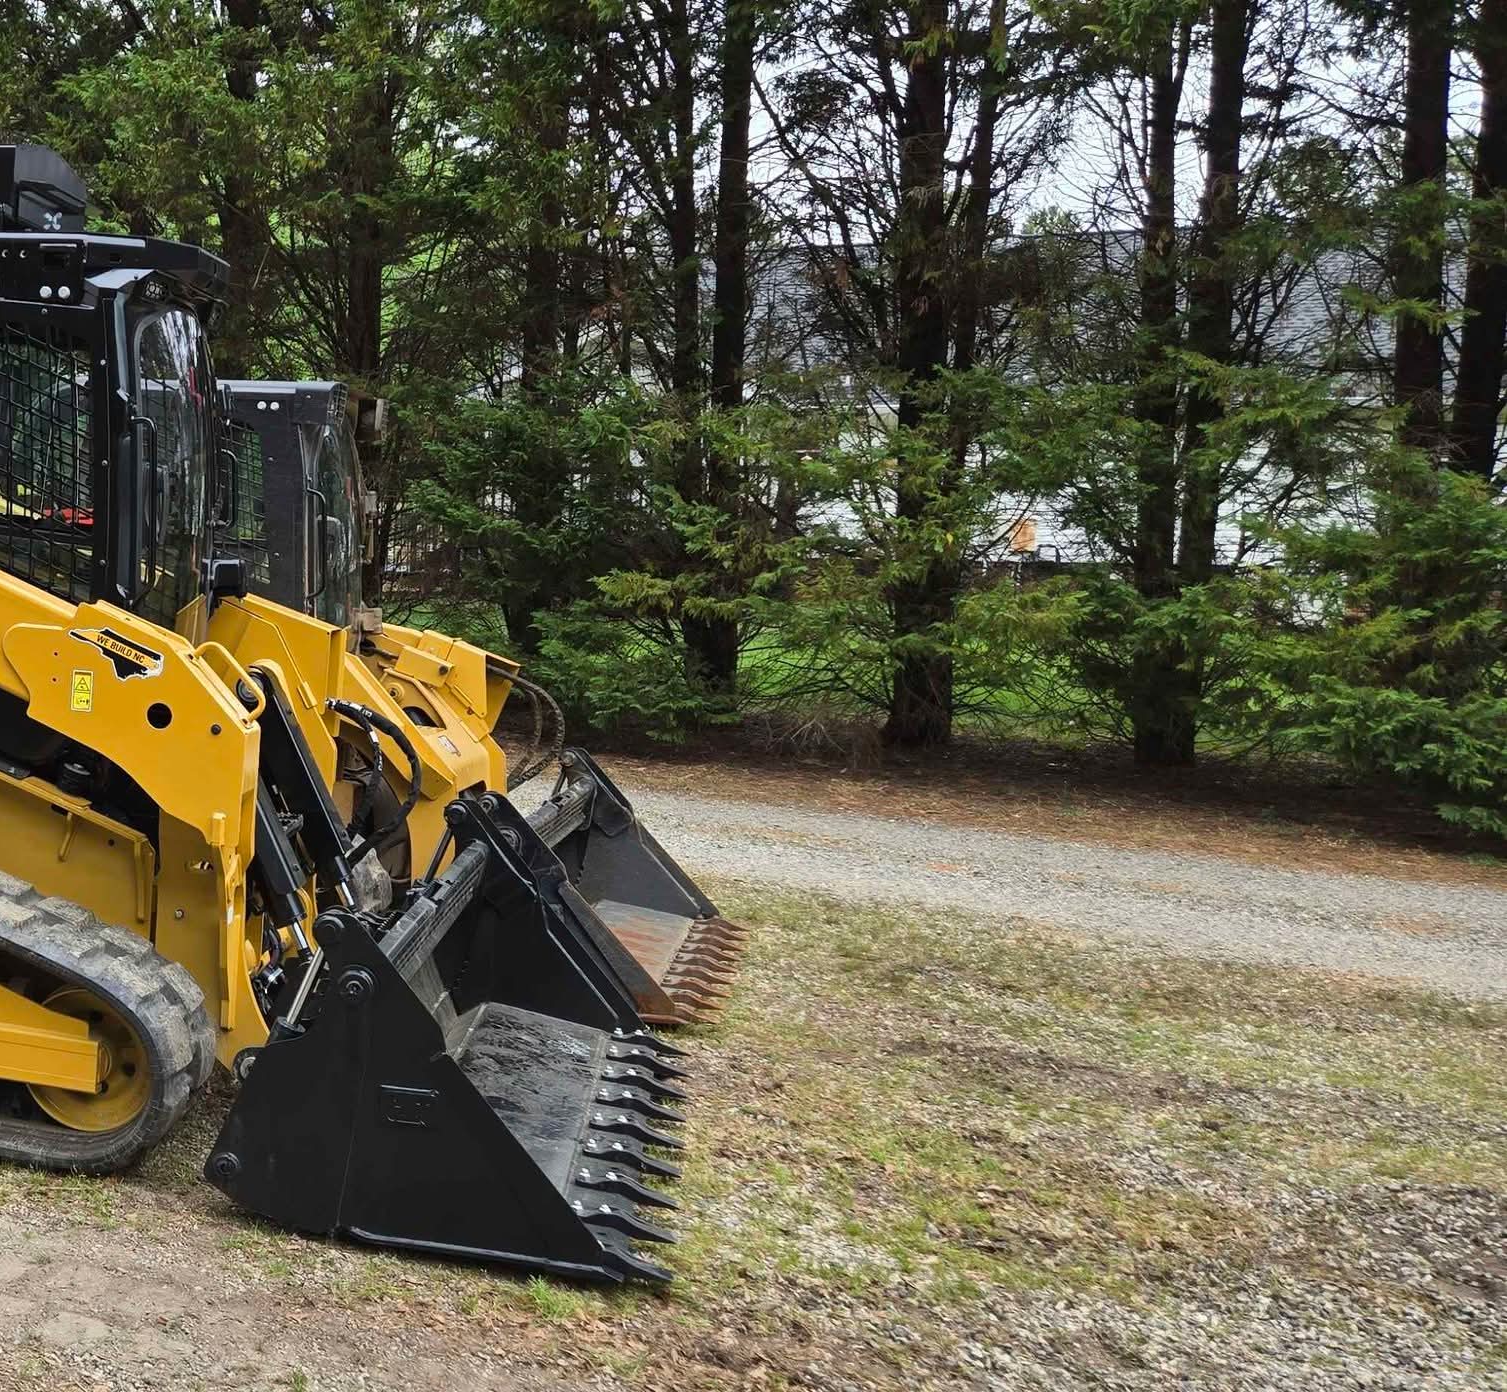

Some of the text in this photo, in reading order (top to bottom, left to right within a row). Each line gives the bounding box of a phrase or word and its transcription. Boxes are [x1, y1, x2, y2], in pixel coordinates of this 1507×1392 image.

[96, 634, 146, 664] WE BUILD NC
